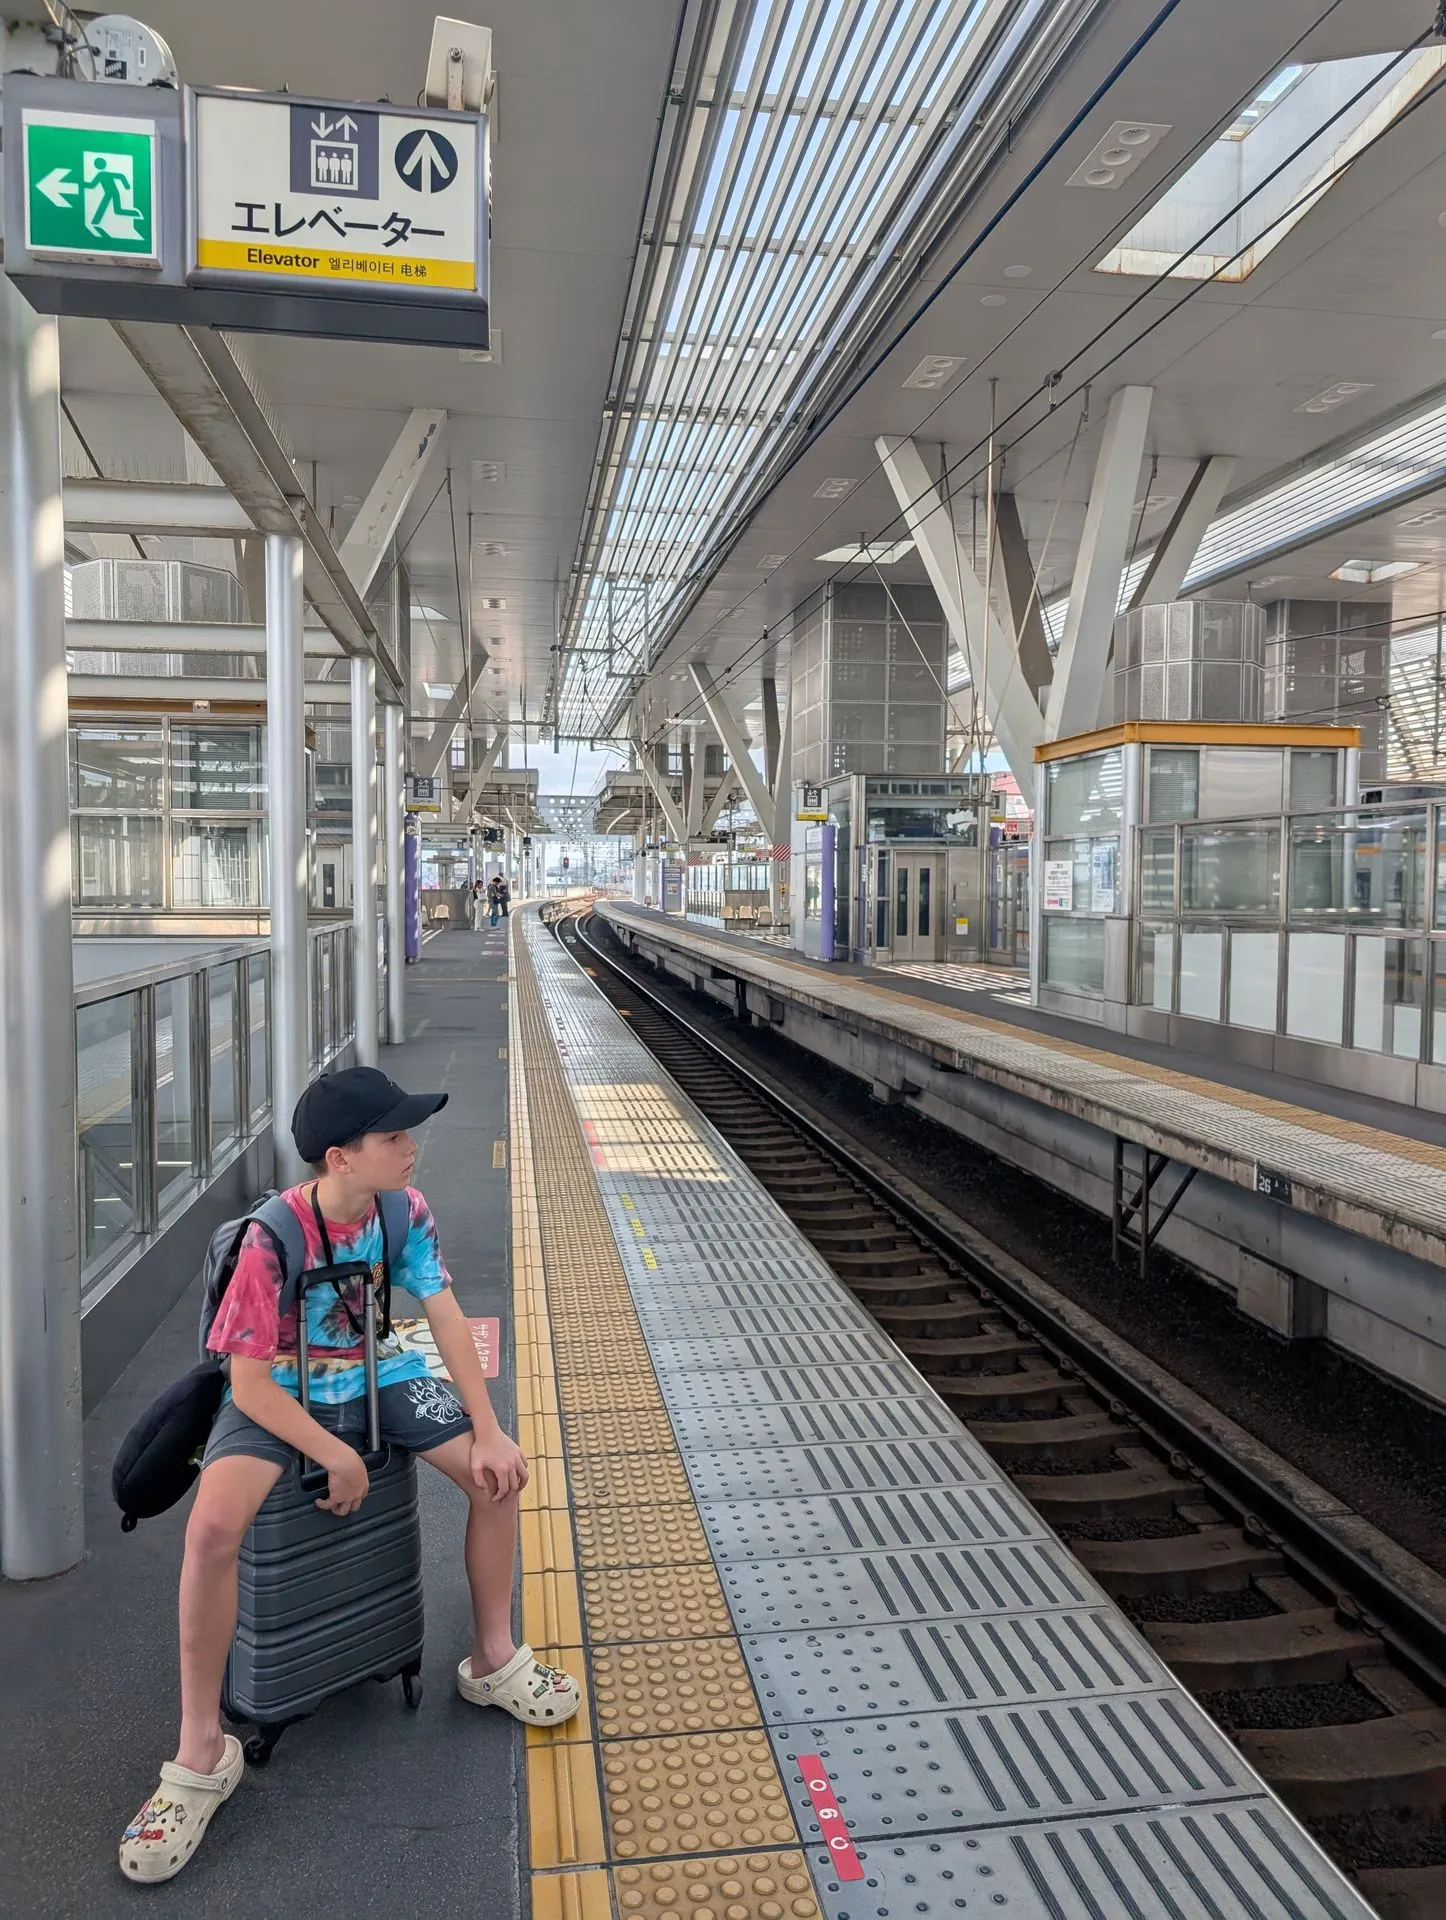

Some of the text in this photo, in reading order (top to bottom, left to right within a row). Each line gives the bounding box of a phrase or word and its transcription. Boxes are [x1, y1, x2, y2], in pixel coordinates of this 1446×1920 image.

[231, 202, 445, 248] エレベーター
[247, 248, 427, 278] Elevator 엘리베이터 电梯
[1258, 1172, 1271, 1194] 26
